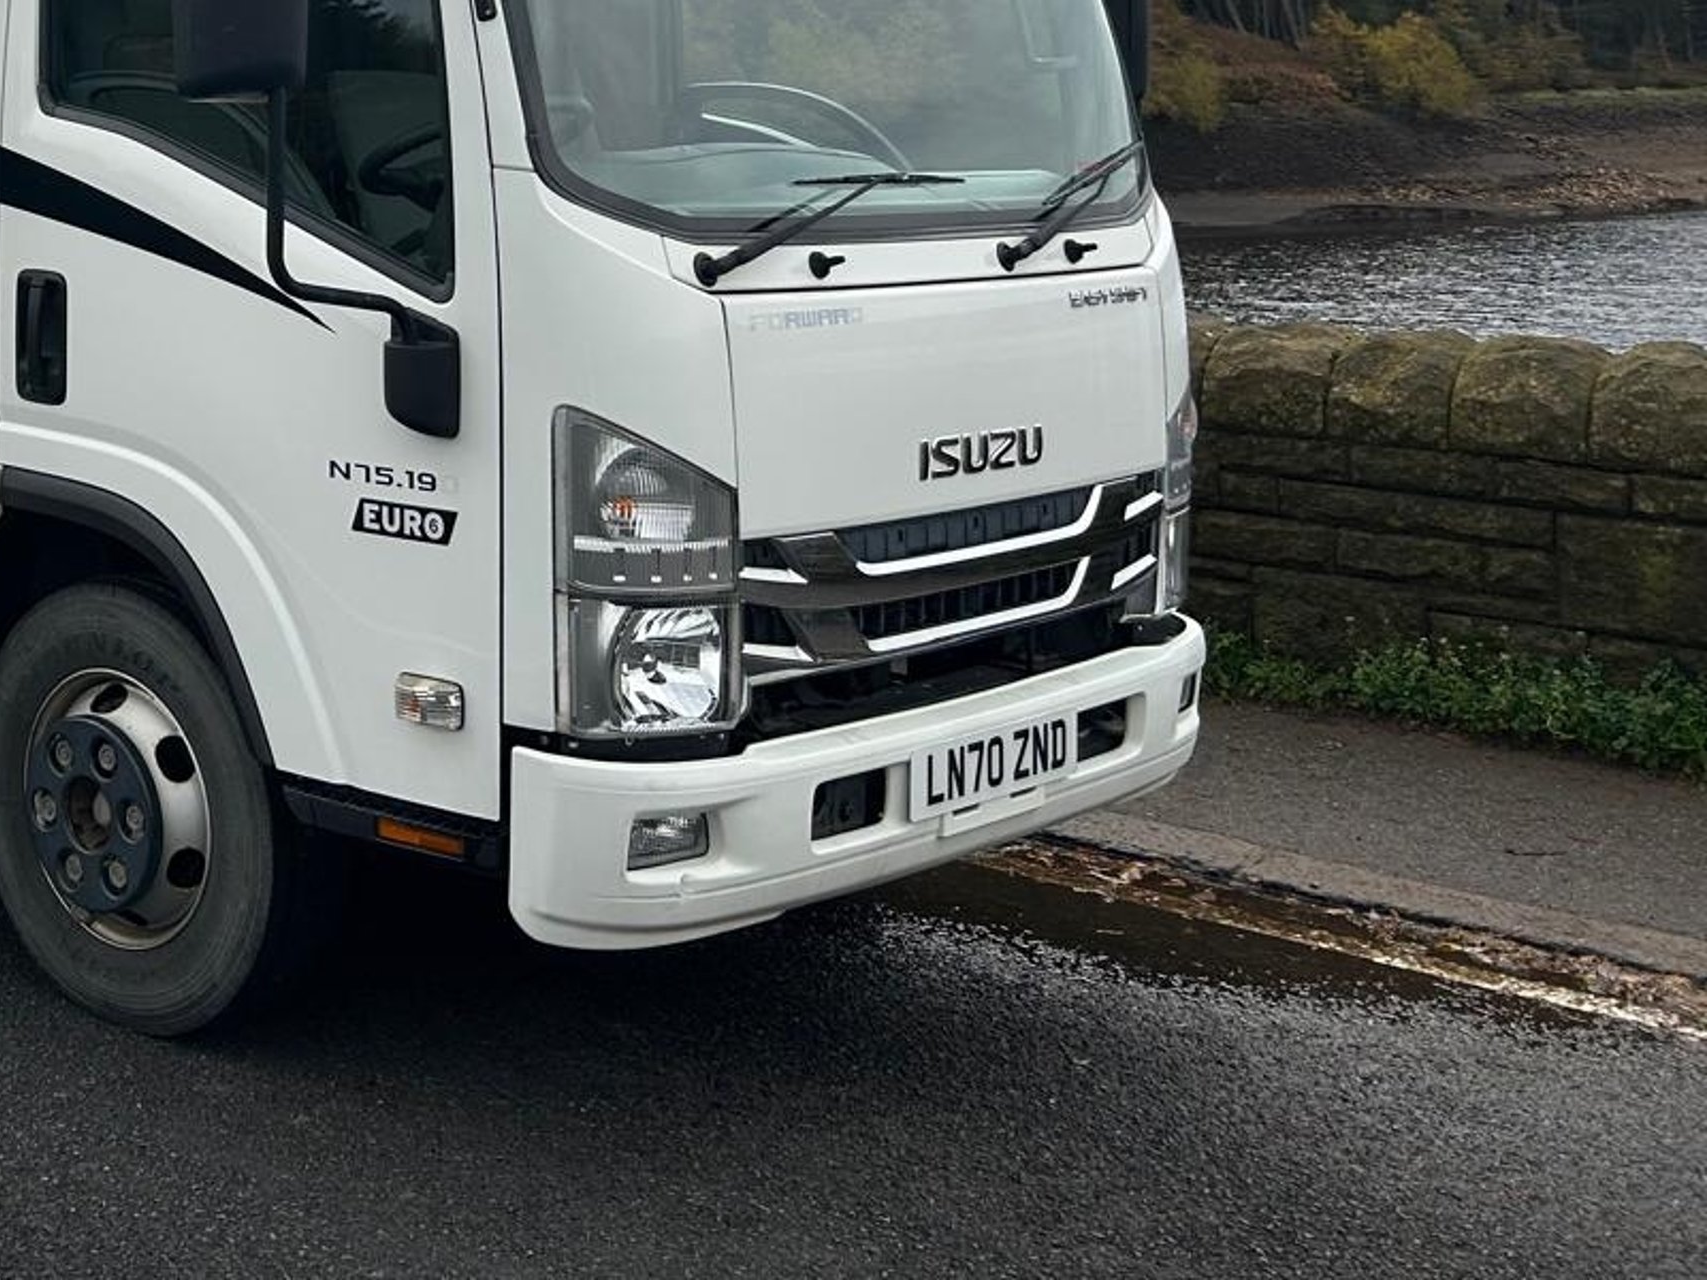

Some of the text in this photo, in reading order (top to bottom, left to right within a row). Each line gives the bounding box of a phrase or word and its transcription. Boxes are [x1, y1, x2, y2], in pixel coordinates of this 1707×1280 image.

[329, 460, 436, 491] N75.19
[919, 426, 1042, 481] ISUZU
[927, 719, 1066, 806] LN70 ZND
